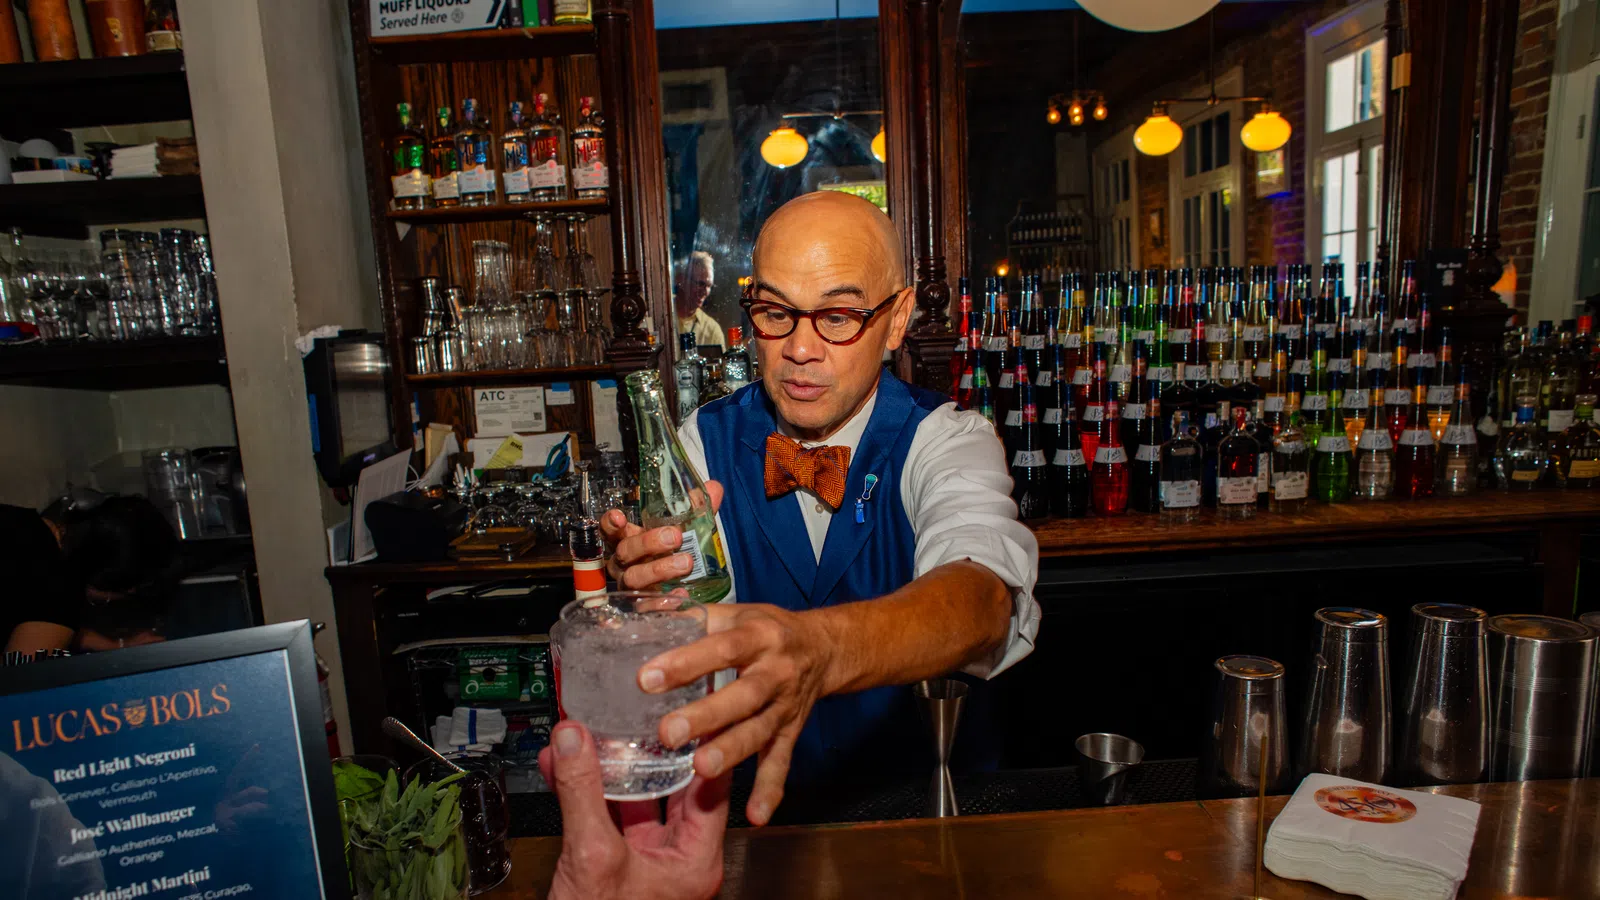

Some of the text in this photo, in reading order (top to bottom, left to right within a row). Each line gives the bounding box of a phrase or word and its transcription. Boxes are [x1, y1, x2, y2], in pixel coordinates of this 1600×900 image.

[379, 0, 412, 14] MUFF
[380, 12, 447, 30] Served Here
[479, 390, 505, 402] ATC
[12, 683, 231, 752] LUCAS BOLS
[53, 743, 196, 783] Red Light Negroni
[58, 786, 110, 803] Genever,
[112, 776, 158, 793] Galliano
[98, 789, 158, 809] Vermouth
[70, 806, 196, 845] José Wallbanger
[57, 823, 219, 867] Galliano Authentico, Mezcal,
[119, 850, 165, 867] Orange
[151, 866, 211, 893] Martini
[204, 882, 253, 900] Curaçao,
